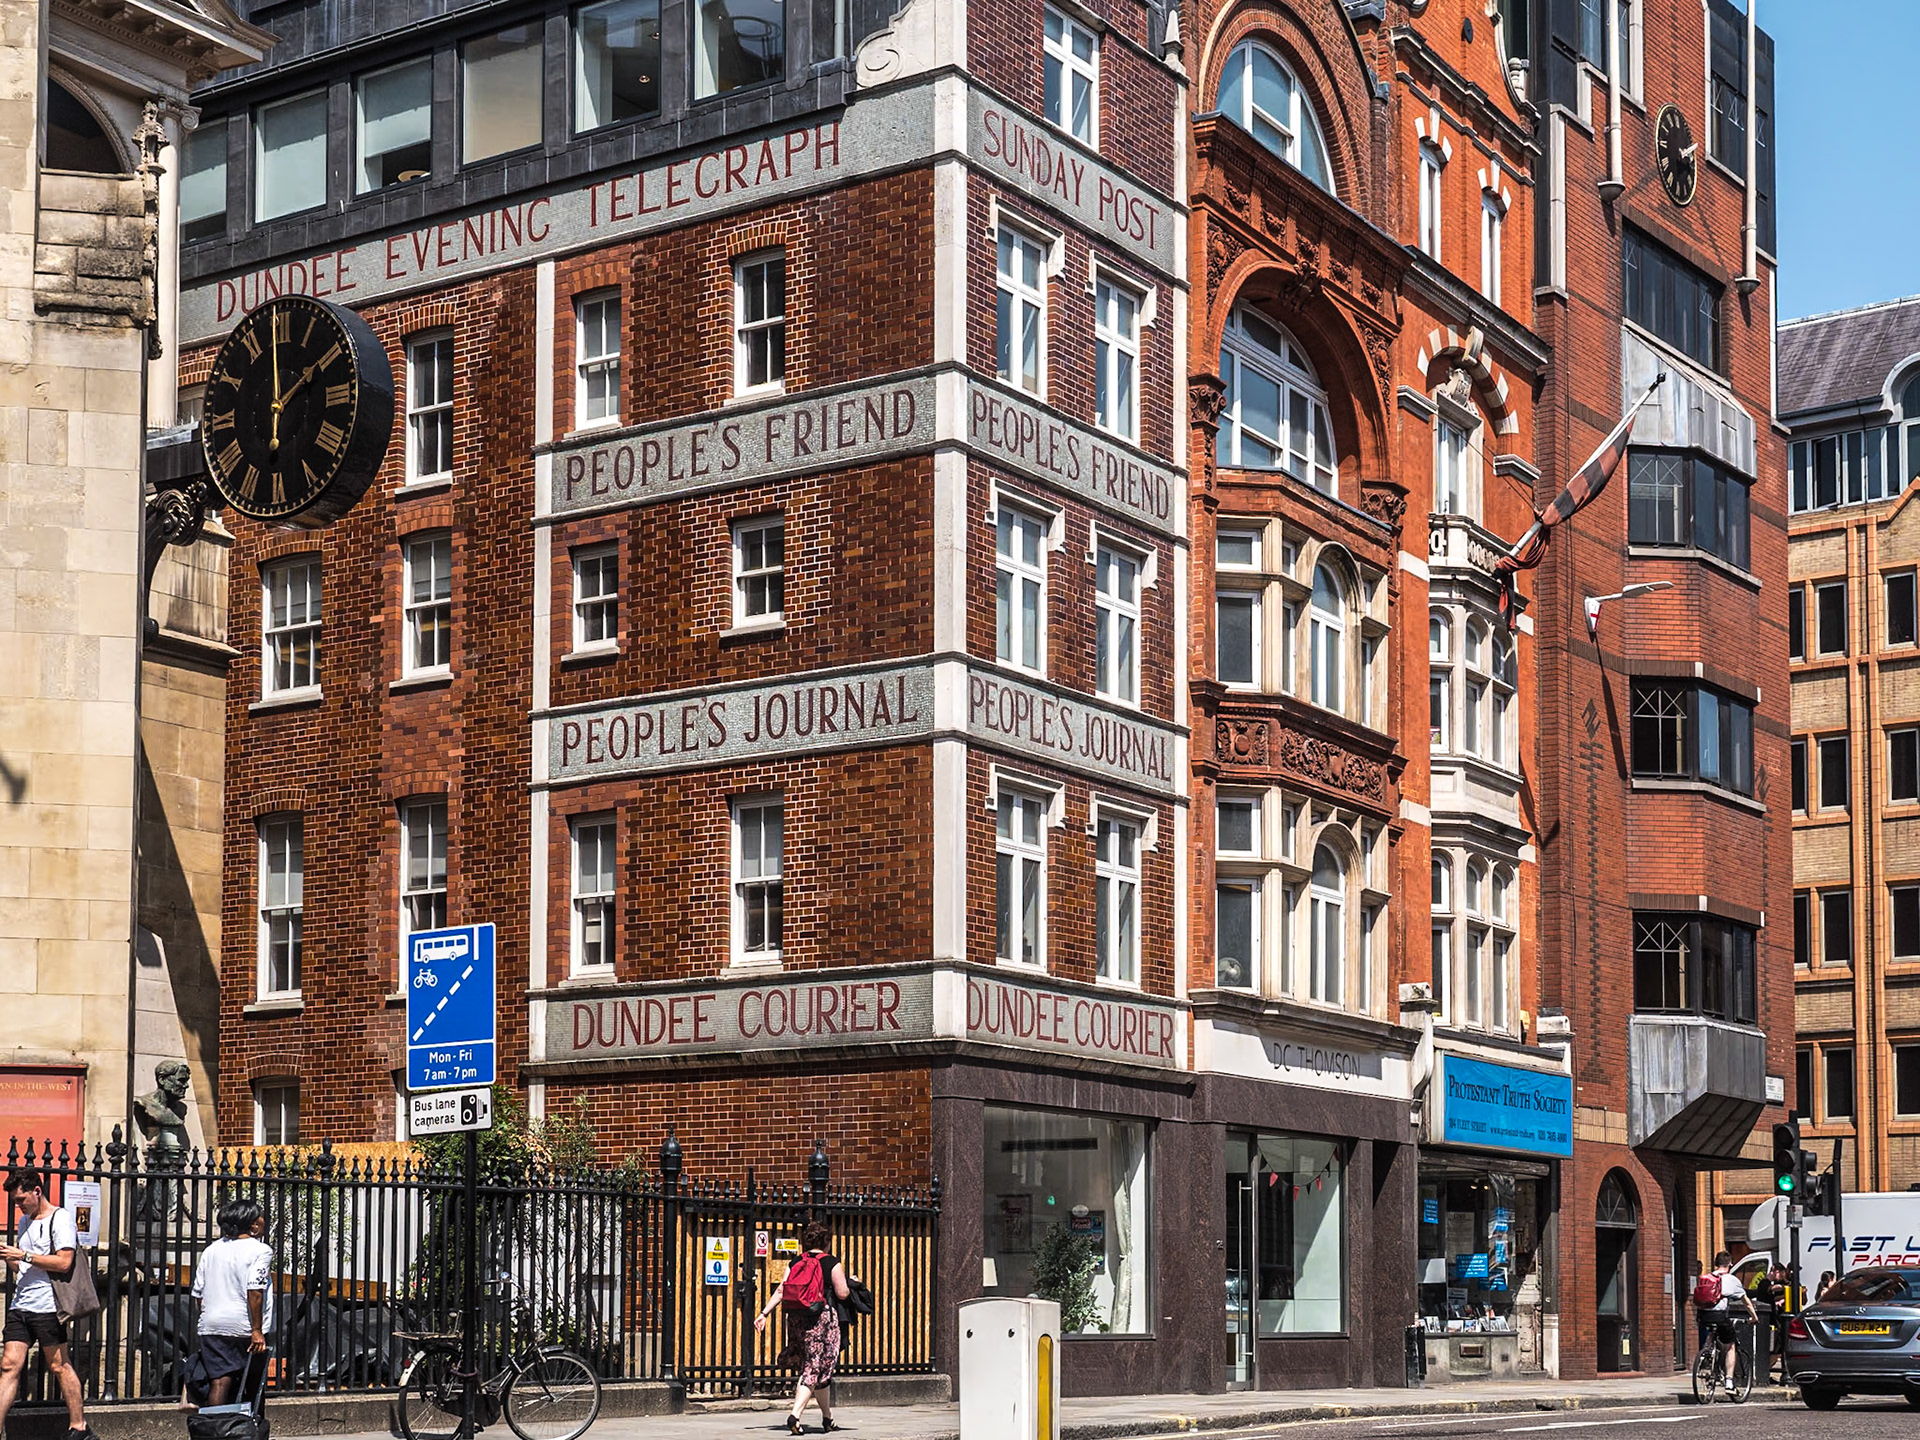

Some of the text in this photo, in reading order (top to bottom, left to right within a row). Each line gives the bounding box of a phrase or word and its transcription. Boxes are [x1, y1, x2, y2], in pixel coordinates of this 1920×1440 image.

[983, 109, 1160, 250] SUNDAY POST
[216, 120, 840, 322] DUNDEE EVENING TELEGRAPH
[566, 389, 916, 501] PEOPLE'S FRIEND
[972, 389, 1170, 521] PEOPLE'S FRIEND
[561, 675, 919, 767] PEOPLE'S JOURNAL
[969, 674, 1172, 782] PEOPLE'S JOURNAL
[572, 980, 902, 1051] DUNDEE COURIER
[966, 980, 1174, 1059] DUNDEE COURIER
[429, 1052, 451, 1063] Mon
[459, 1049, 472, 1061] Fri
[1273, 1042, 1360, 1080] DC THOMSON
[414, 1098, 456, 1112] Bus lane
[414, 1114, 455, 1127] cameras
[1448, 1074, 1567, 1114] PROTESTANT TRUTH SOCIETY
[1808, 1236, 1896, 1251] FAST
[1851, 1254, 1920, 1266] PARC
